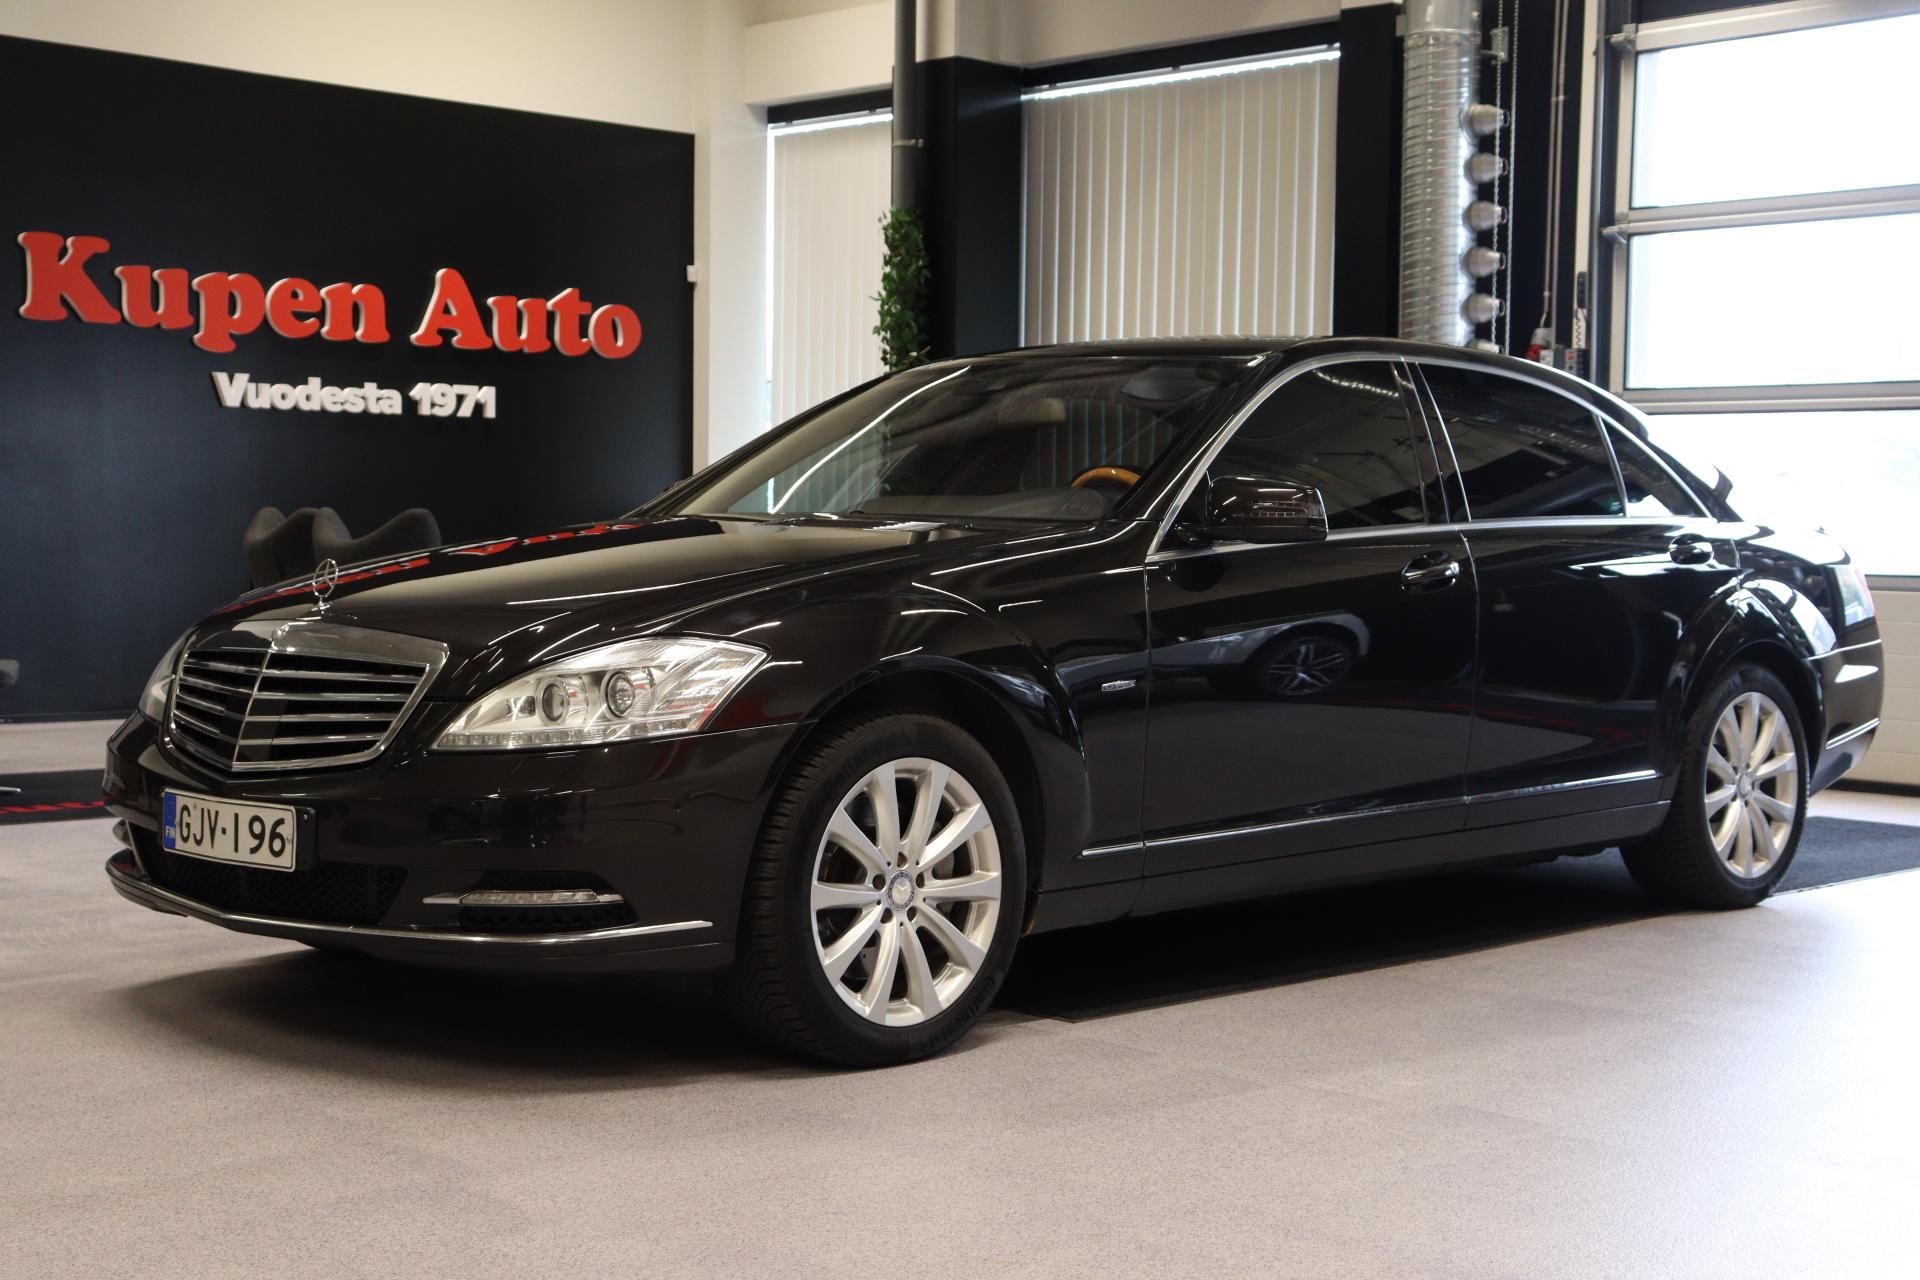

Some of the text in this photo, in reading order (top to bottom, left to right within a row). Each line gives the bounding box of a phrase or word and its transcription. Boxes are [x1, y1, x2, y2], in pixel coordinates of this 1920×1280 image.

[17, 231, 642, 358] Kupen Auto
[212, 371, 497, 419] Vuodesta 1971
[179, 804, 286, 858] GJV-196
